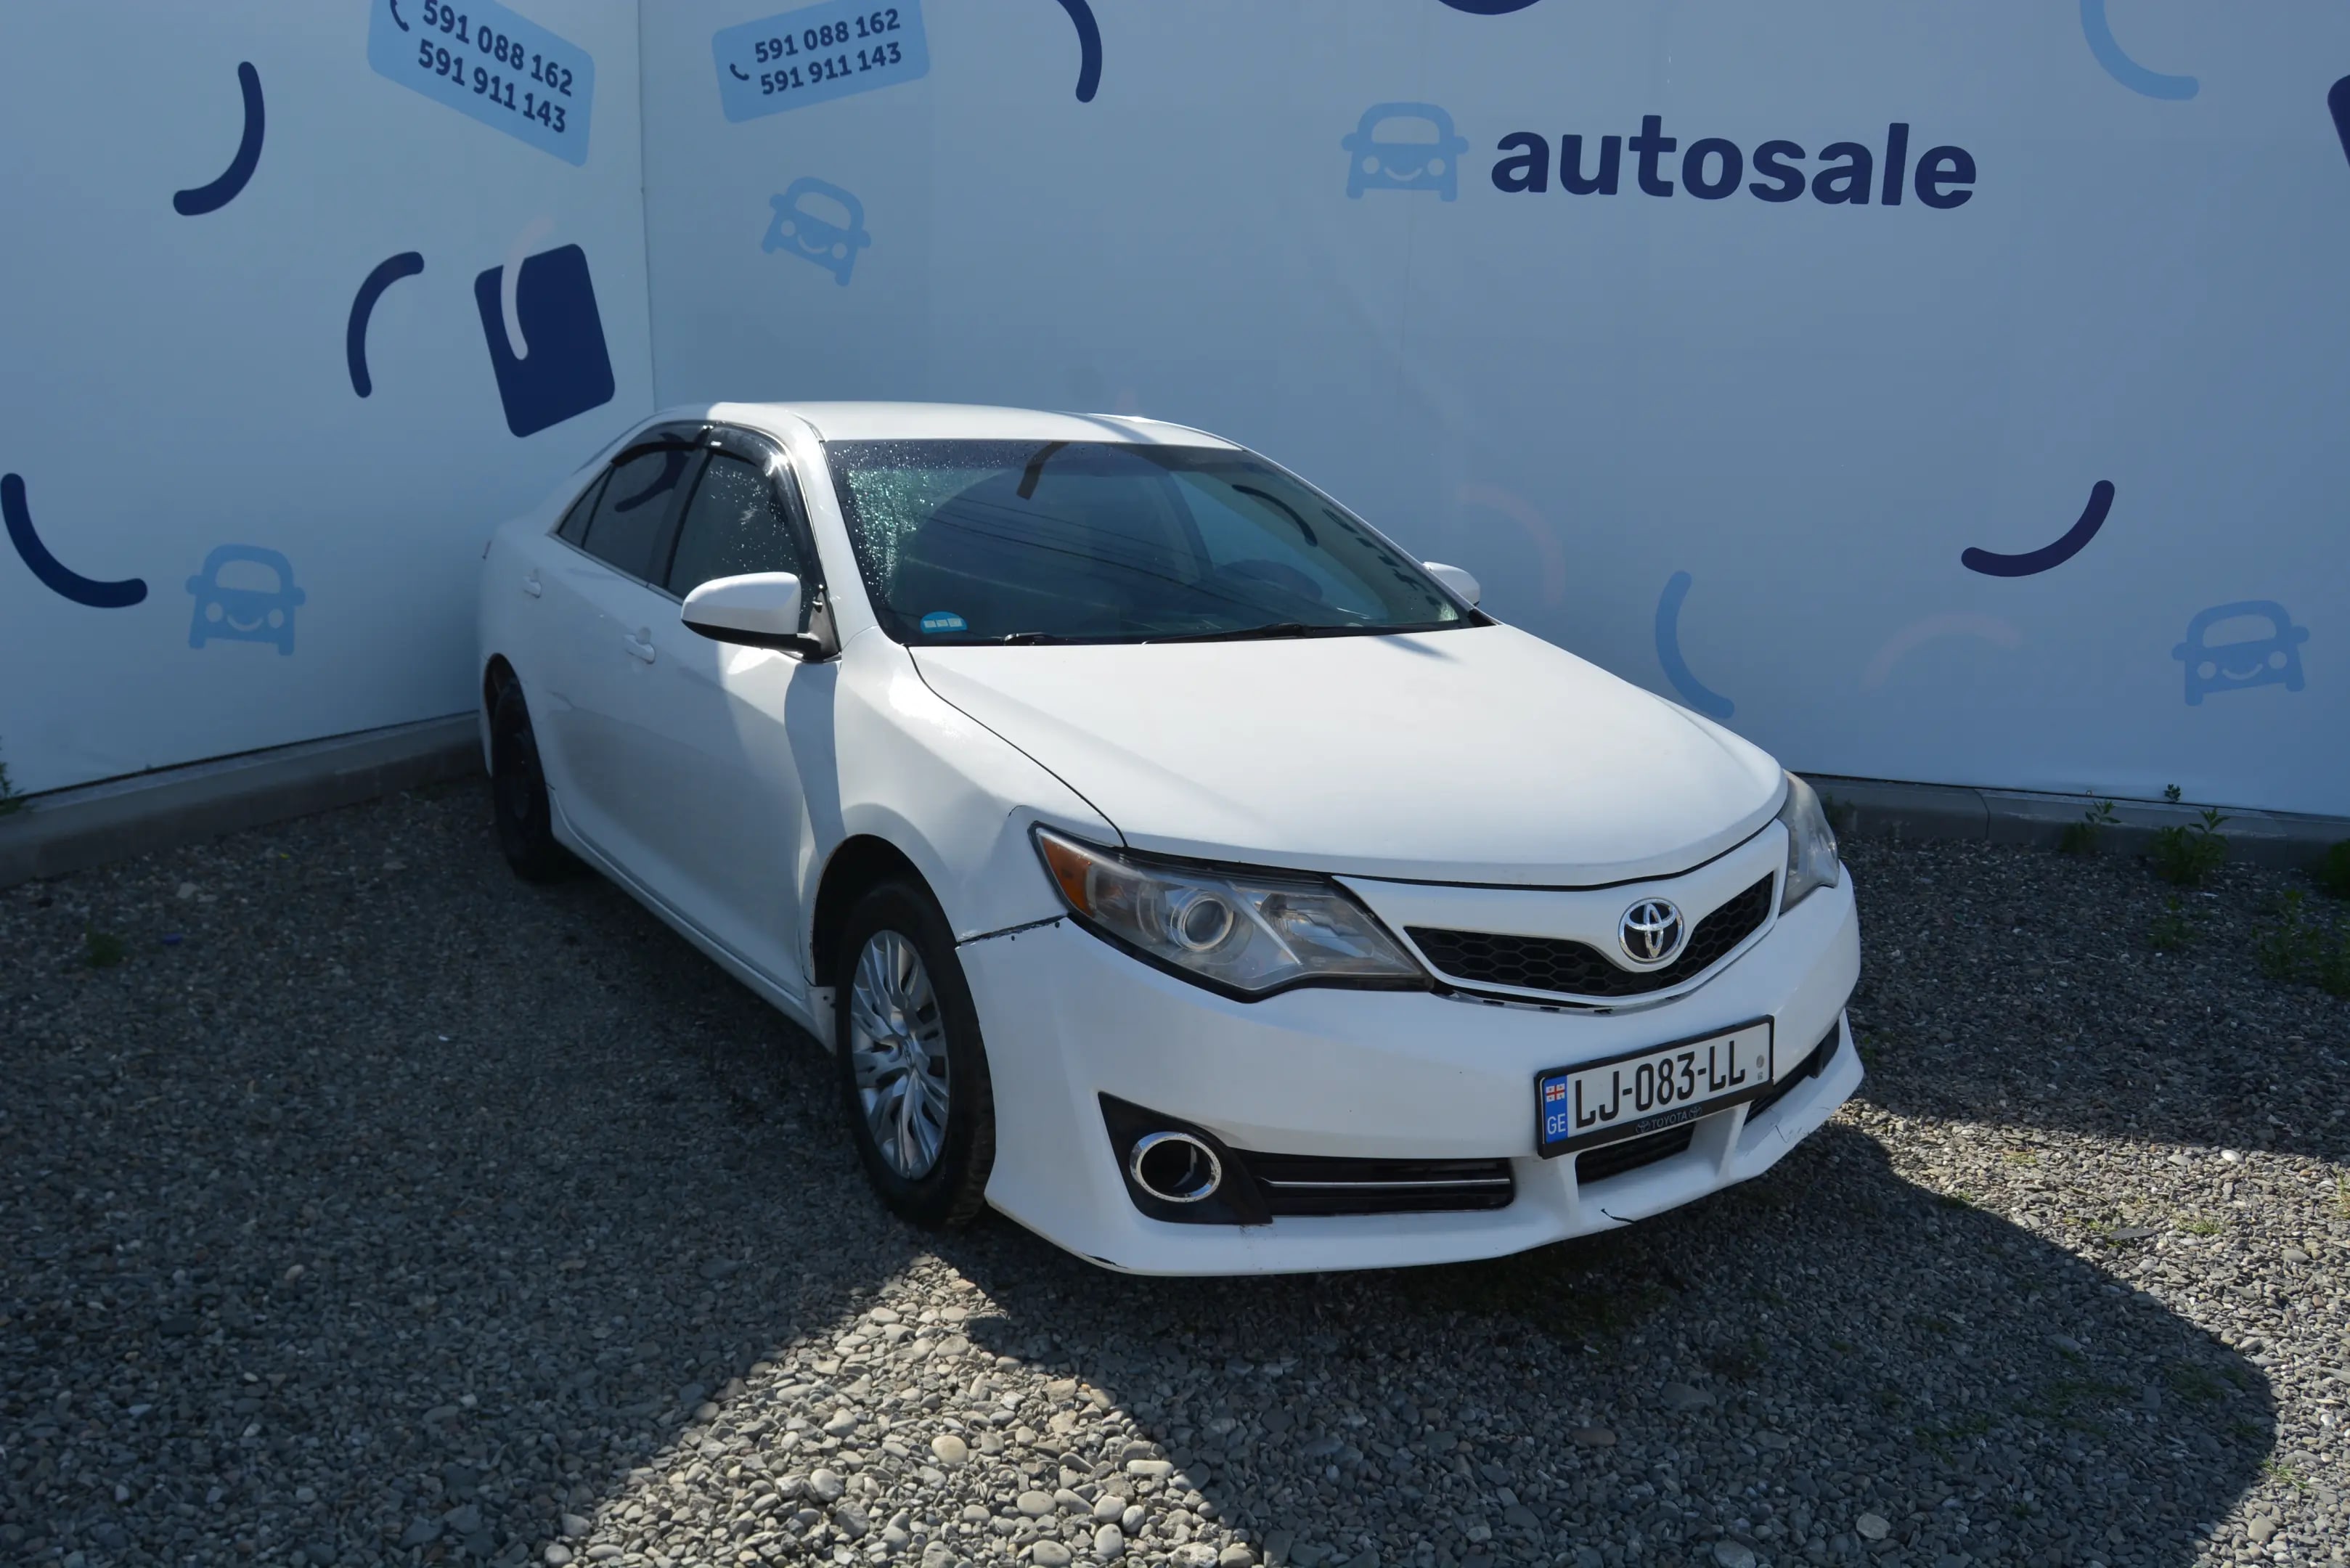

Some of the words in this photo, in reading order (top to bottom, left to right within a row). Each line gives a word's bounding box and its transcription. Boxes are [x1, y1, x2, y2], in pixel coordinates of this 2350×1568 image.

[423, 0, 470, 44] 591
[478, 25, 524, 71] 088
[531, 54, 574, 97] 162
[755, 34, 799, 63] 591
[803, 21, 849, 51] 088
[855, 8, 901, 38] 162
[760, 66, 804, 95] 591
[808, 54, 852, 84] 911
[857, 41, 902, 73] 143
[418, 38, 465, 86] 591
[473, 67, 517, 111] 911
[523, 92, 566, 134] 143
[1491, 115, 1977, 210] autosale
[1575, 1040, 1745, 1130] LJ-083-LL
[1651, 1110, 1688, 1130] TOYOTA
[1546, 1112, 1566, 1135] GE
